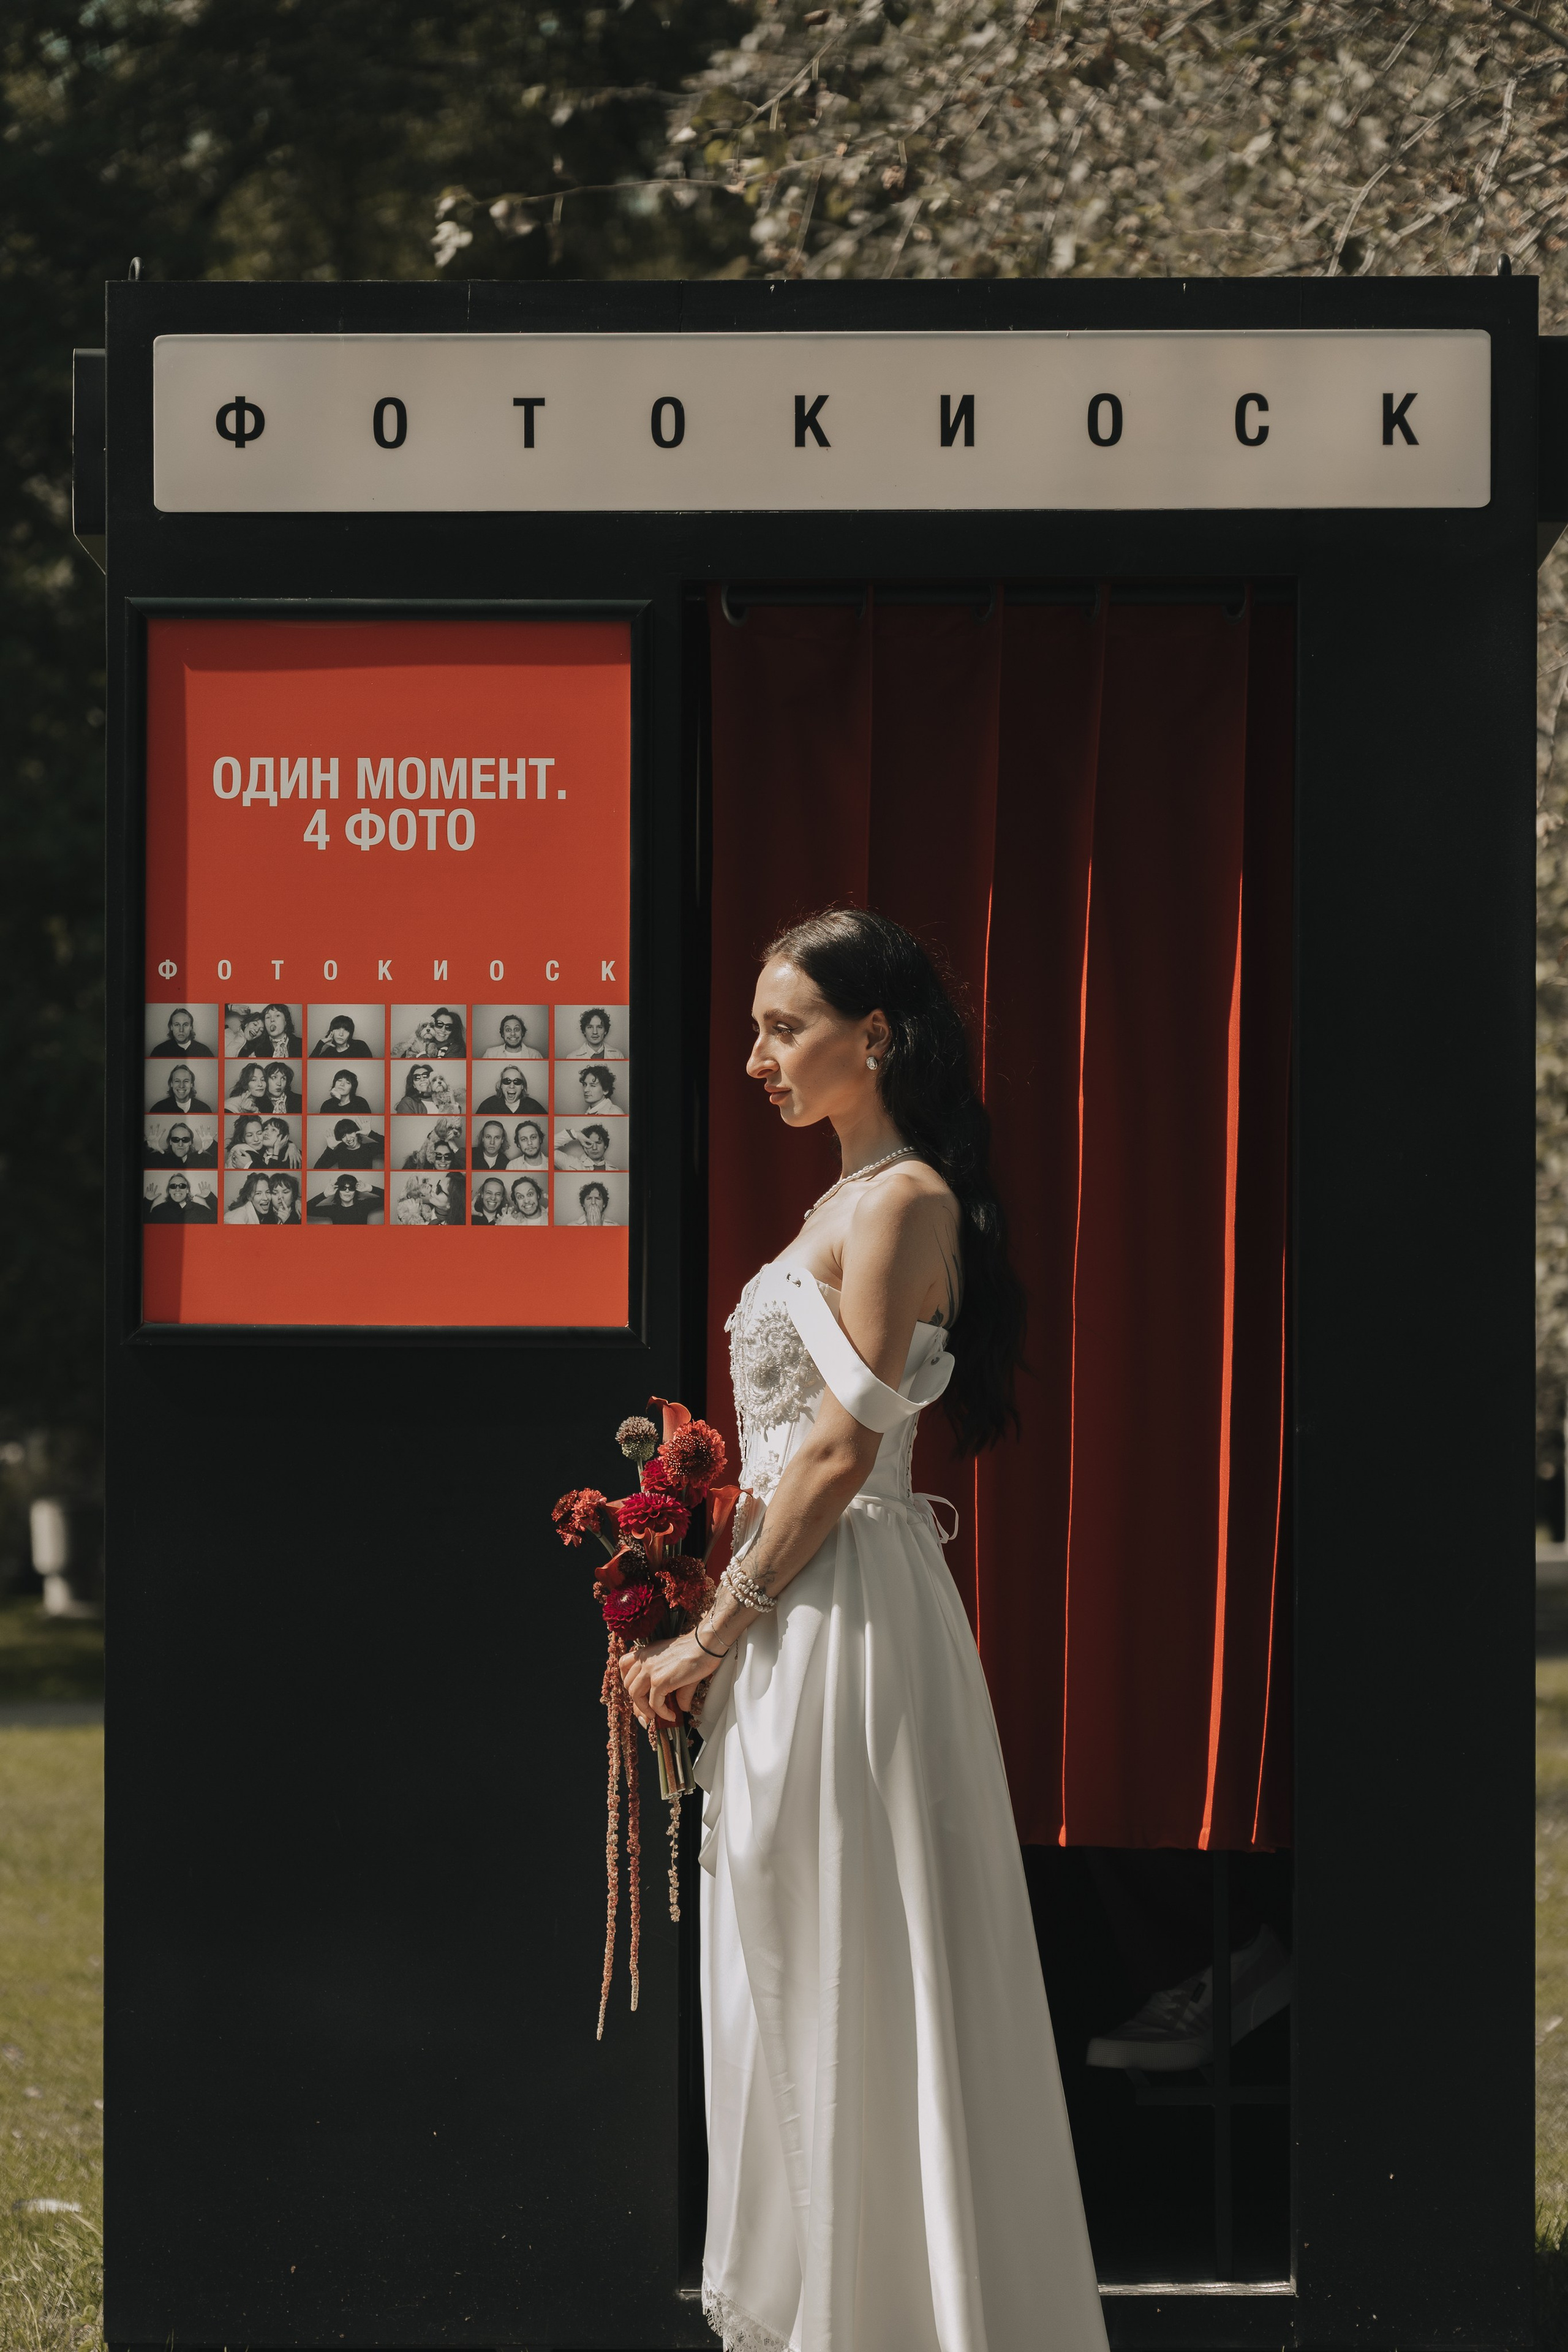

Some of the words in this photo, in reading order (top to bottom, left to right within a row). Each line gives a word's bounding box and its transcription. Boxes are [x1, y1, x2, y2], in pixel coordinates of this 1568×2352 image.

[215, 392, 1420, 450] ФОТОКИОСК
[213, 756, 339, 807] ОДИН
[356, 756, 567, 800] МОМЕНТ.
[303, 809, 331, 851] 4
[345, 808, 476, 851] ФОТО
[157, 959, 617, 982] ФОТОКИОСК
